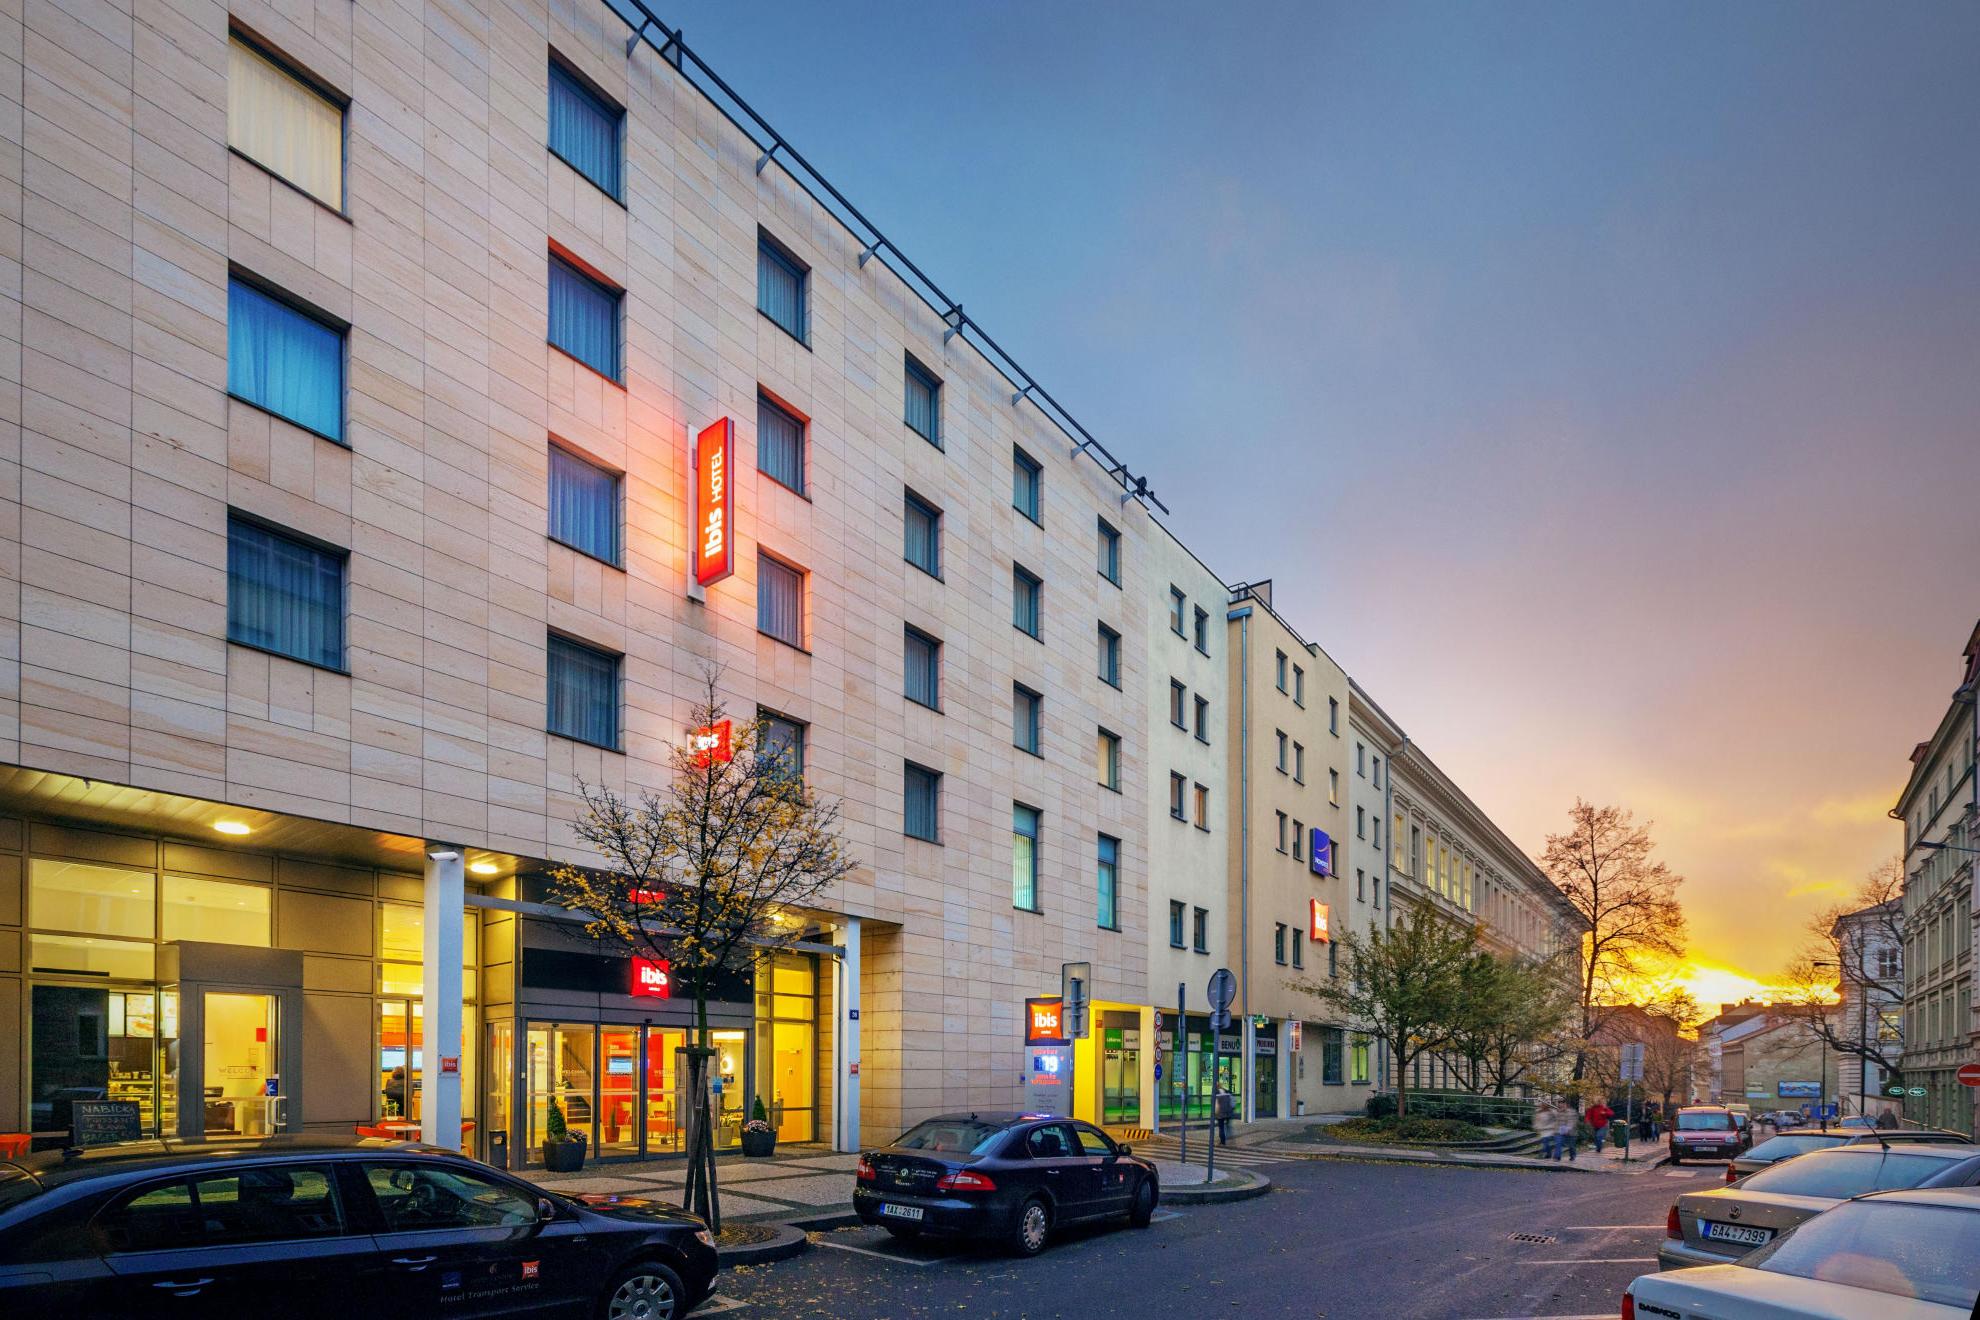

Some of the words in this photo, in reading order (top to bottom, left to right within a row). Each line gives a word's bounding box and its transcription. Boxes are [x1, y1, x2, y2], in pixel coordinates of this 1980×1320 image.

[711, 446, 723, 503] HOTEL
[704, 507, 723, 558] ibis
[641, 967, 668, 985] ibis
[1034, 1012, 1058, 1028] ibis
[1221, 1040, 1236, 1050] BENU
[444, 1060, 456, 1068] ibis
[886, 1204, 898, 1215] 1AX
[902, 1207, 920, 1218] 2611
[1711, 1224, 1730, 1238] 6A4
[1737, 1228, 1766, 1244] 7399
[524, 1265, 538, 1275] ibis
[468, 1287, 509, 1300] Transport
[512, 1282, 540, 1294] Service
[1638, 1302, 1681, 1319] DAEWOO
